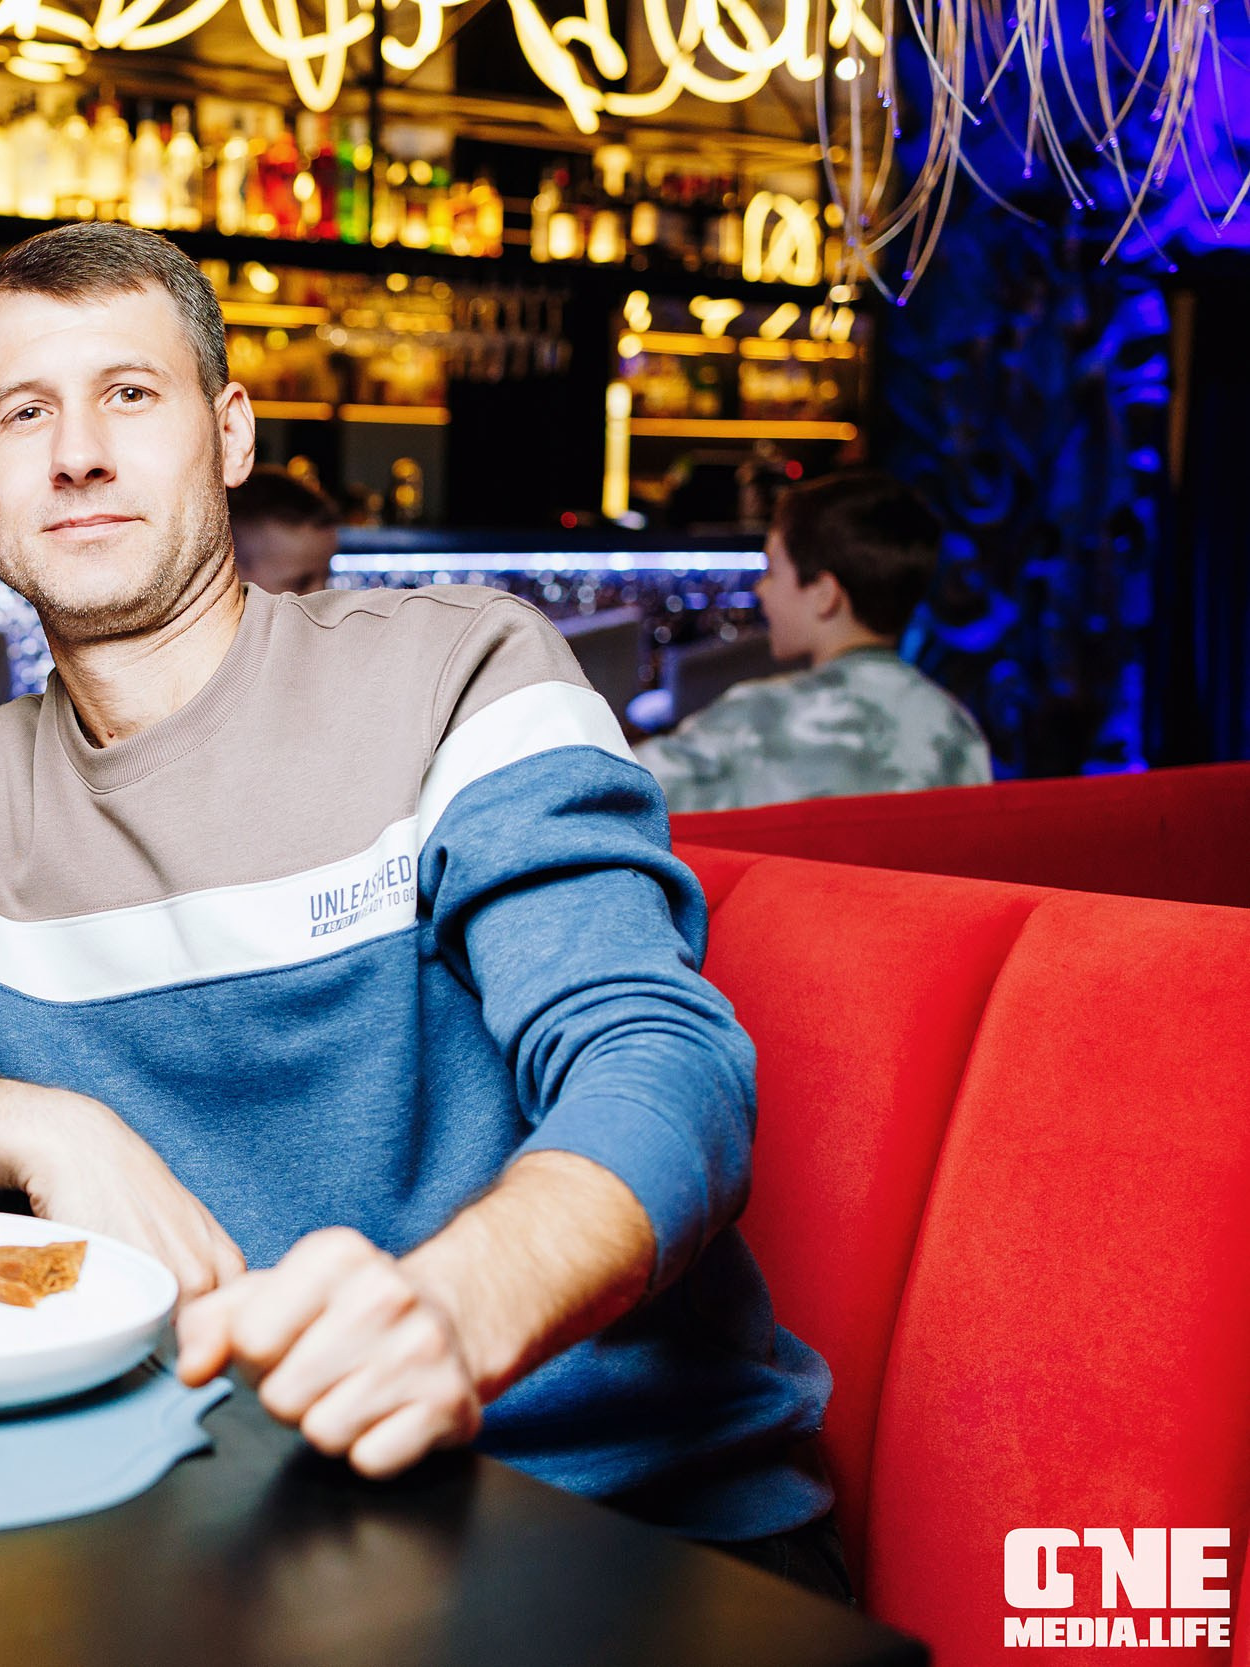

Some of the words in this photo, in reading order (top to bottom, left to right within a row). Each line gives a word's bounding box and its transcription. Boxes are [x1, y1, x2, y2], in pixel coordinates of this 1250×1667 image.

[310, 855, 412, 921] UNLEASHED
[387, 891, 400, 907] TO
[403, 886, 415, 902] GO
